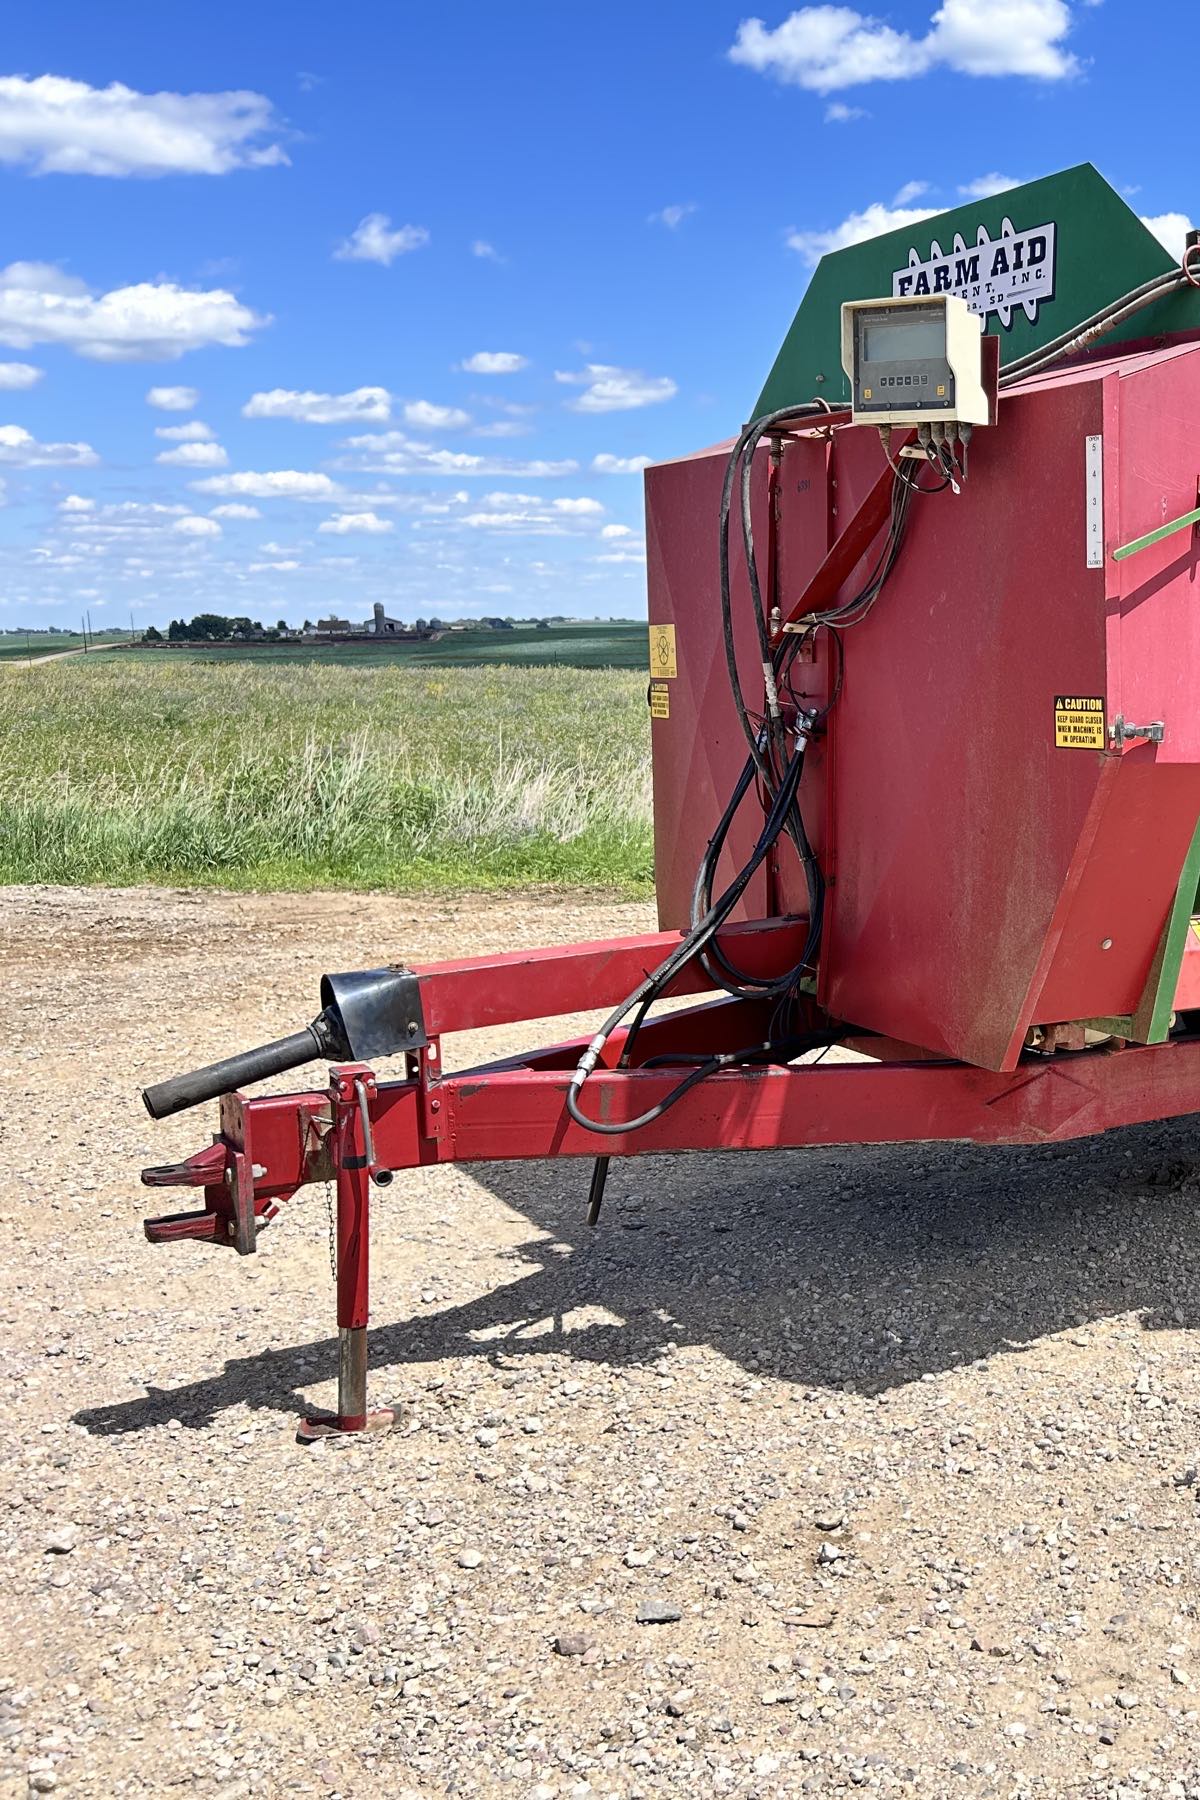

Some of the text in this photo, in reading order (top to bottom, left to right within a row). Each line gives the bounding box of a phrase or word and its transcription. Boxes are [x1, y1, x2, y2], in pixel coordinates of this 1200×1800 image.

[898, 235, 1047, 297] FARM AID
[1011, 268, 1046, 287] INC.
[989, 293, 1004, 305] SD
[1091, 443, 1097, 452] 5
[1091, 470, 1097, 478] 4
[1092, 497, 1097, 506] 3
[1092, 523, 1097, 533] 2
[1092, 551, 1097, 560] 1
[1064, 698, 1103, 711] CAUTION
[1057, 715, 1102, 725] KEEP GUARD CLOSED
[1057, 725, 1103, 735] WHEN MACHINE IS
[1062, 735, 1097, 744] IN OPERATION
